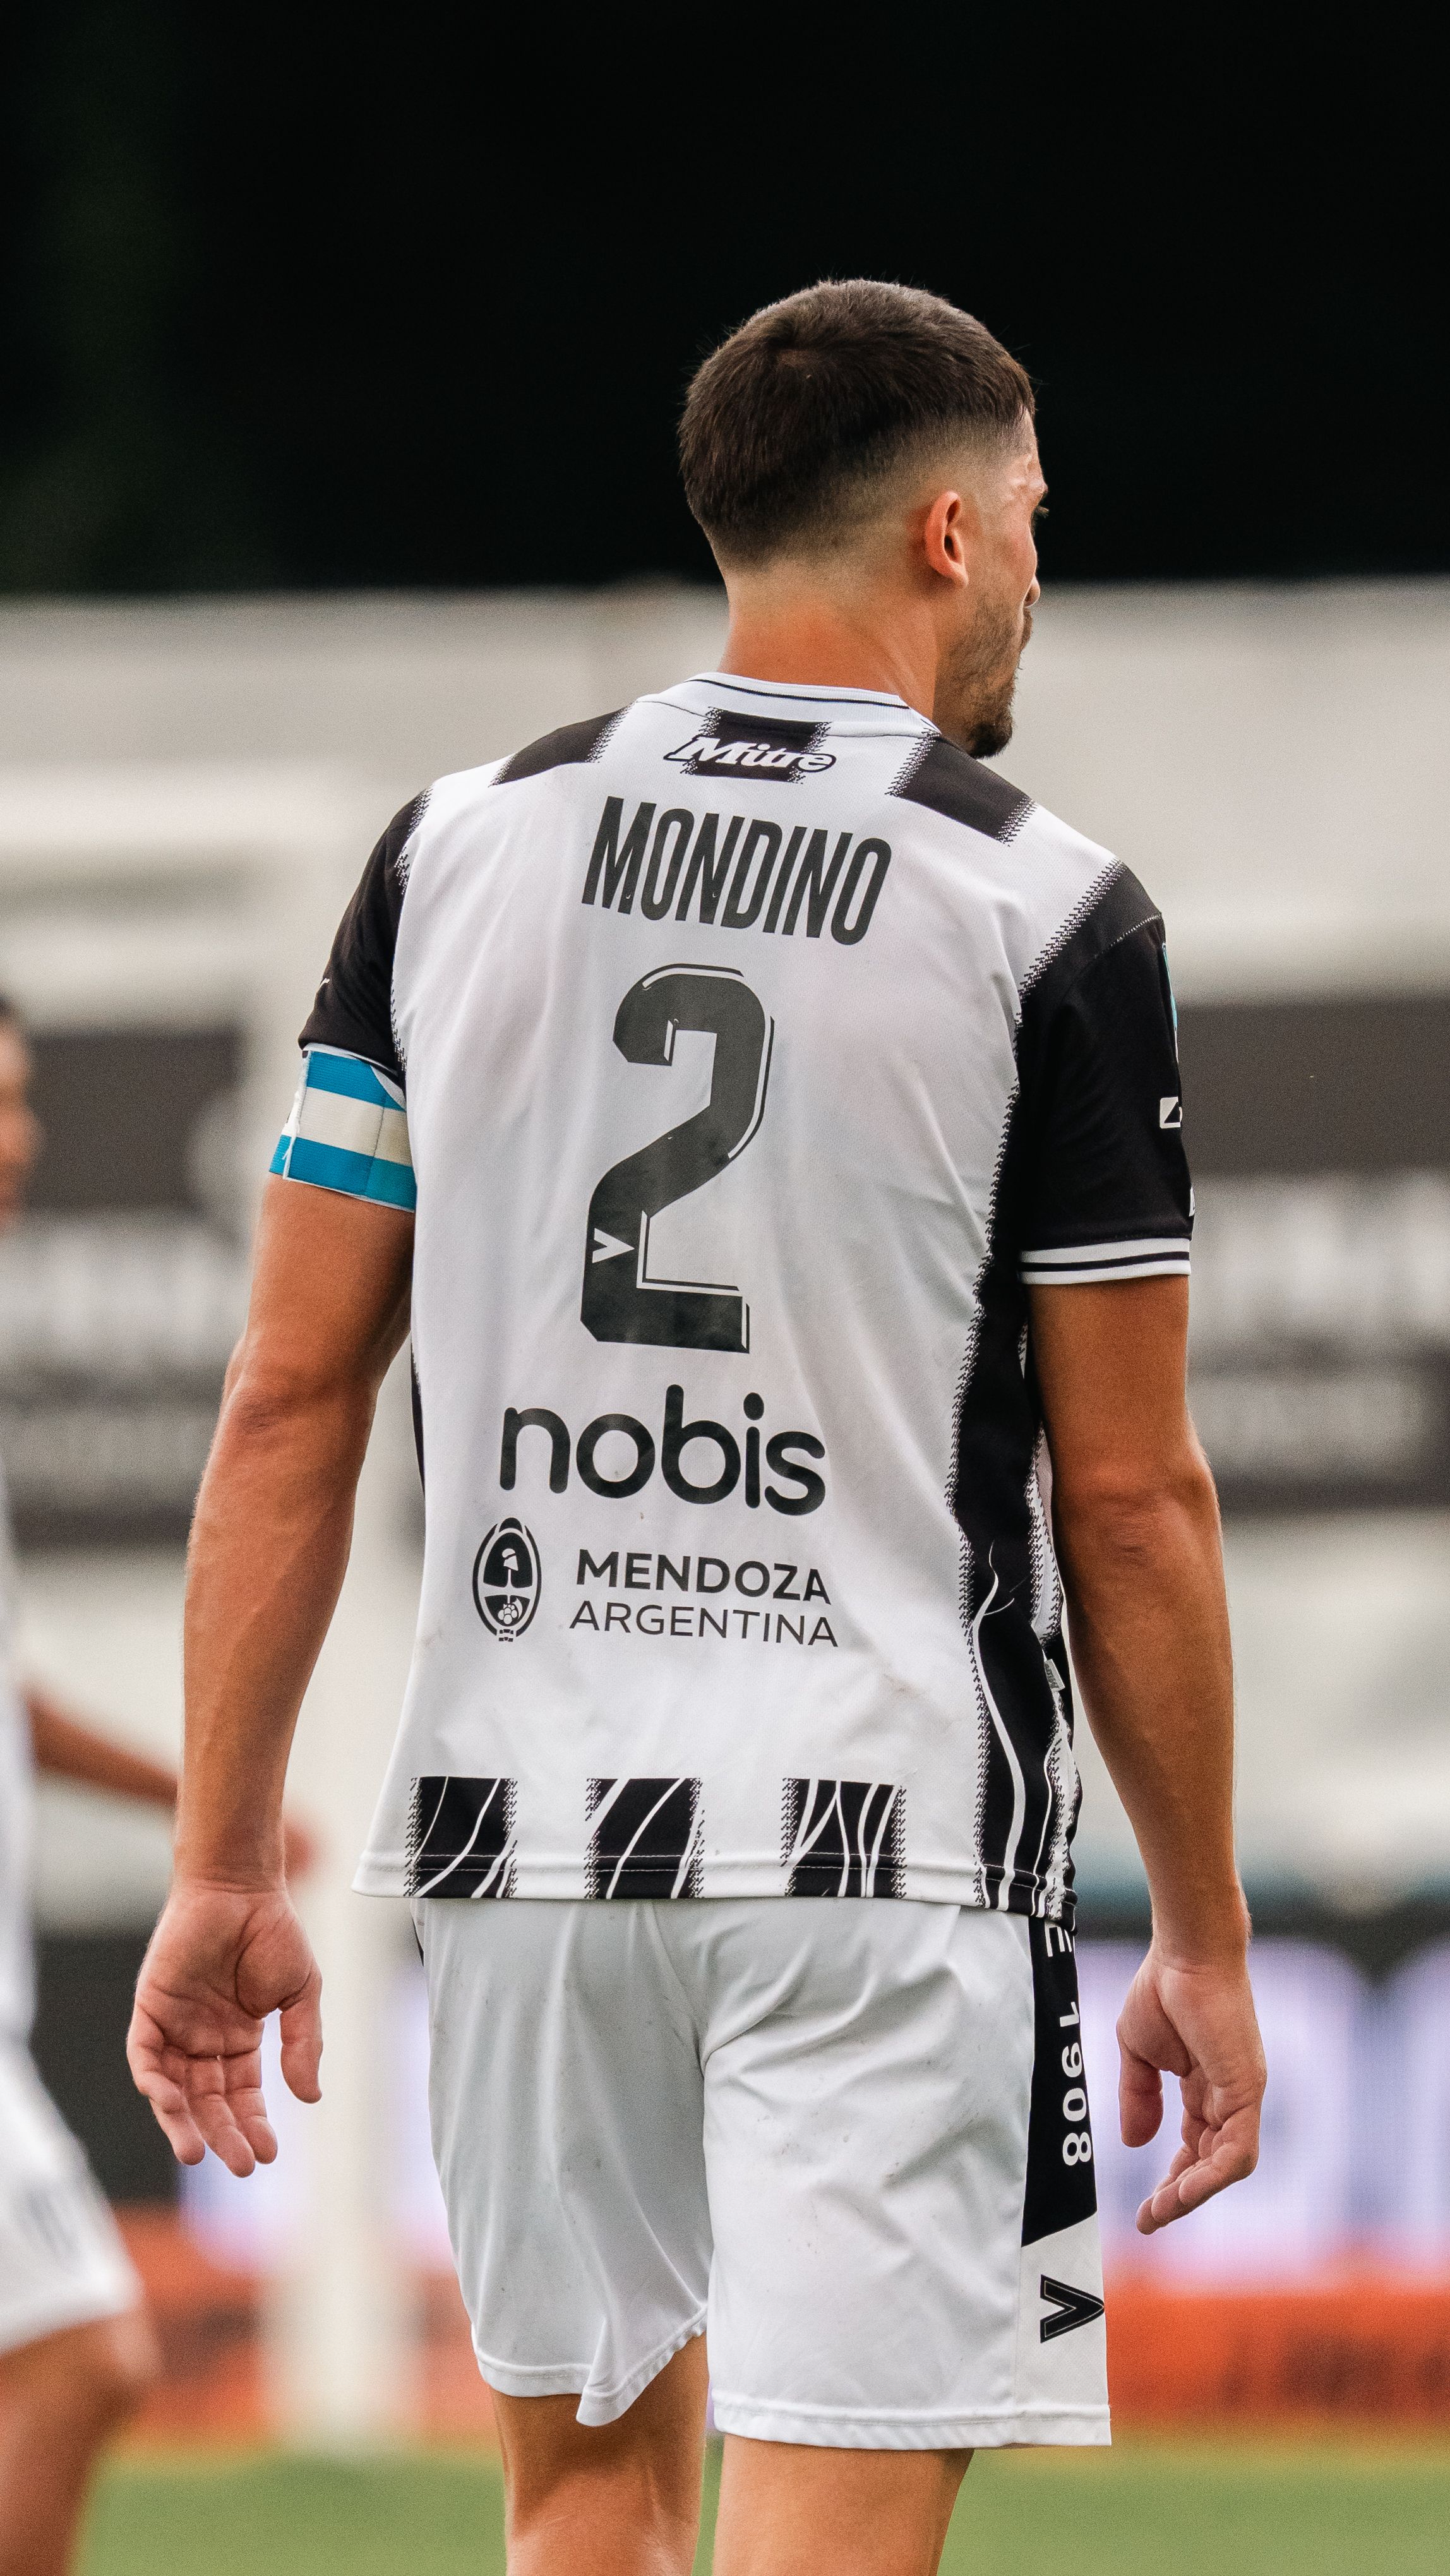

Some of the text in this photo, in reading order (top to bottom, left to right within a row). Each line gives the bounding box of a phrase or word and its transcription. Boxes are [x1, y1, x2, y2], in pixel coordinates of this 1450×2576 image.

[665, 735, 834, 772] Mitre
[582, 796, 892, 945] MONDINO
[580, 964, 774, 1354] 2
[500, 1384, 825, 1516] nobis
[569, 1600, 839, 1647] ARGENTINA
[577, 1549, 832, 1605] MENDOZA
[1059, 2001, 1092, 2166] 1908
